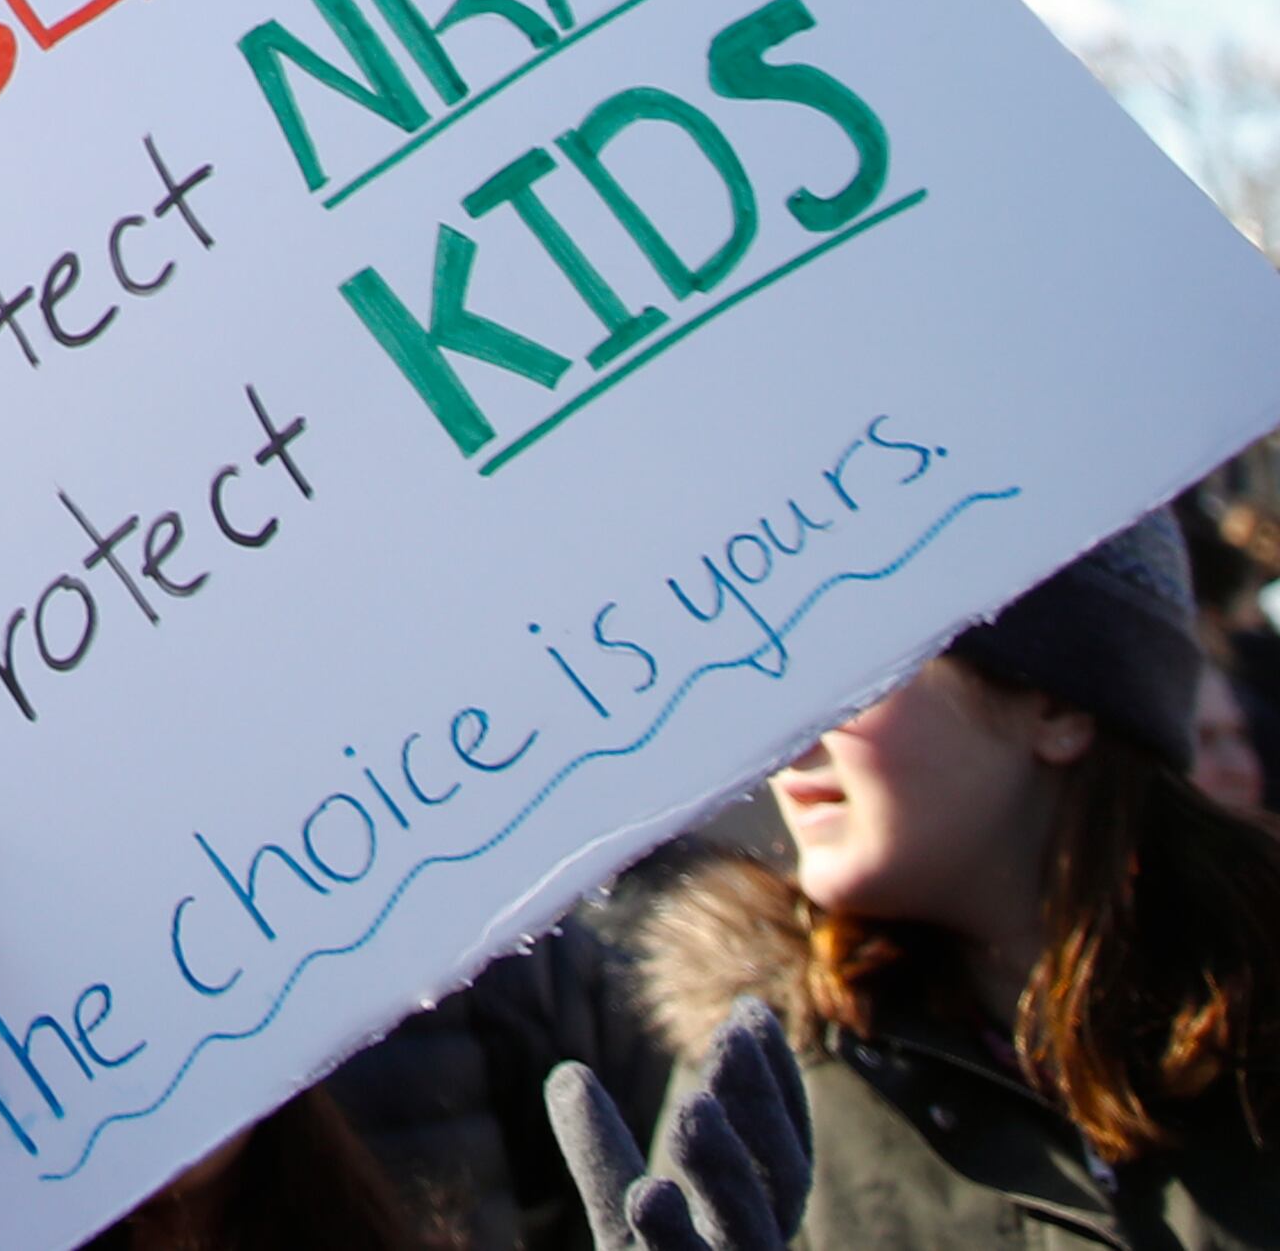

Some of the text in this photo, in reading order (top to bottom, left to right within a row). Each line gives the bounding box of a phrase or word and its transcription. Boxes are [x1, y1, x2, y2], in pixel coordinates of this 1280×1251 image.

[170, 707, 540, 997] choice
[528, 602, 659, 719] is
[667, 414, 950, 679] yours.
